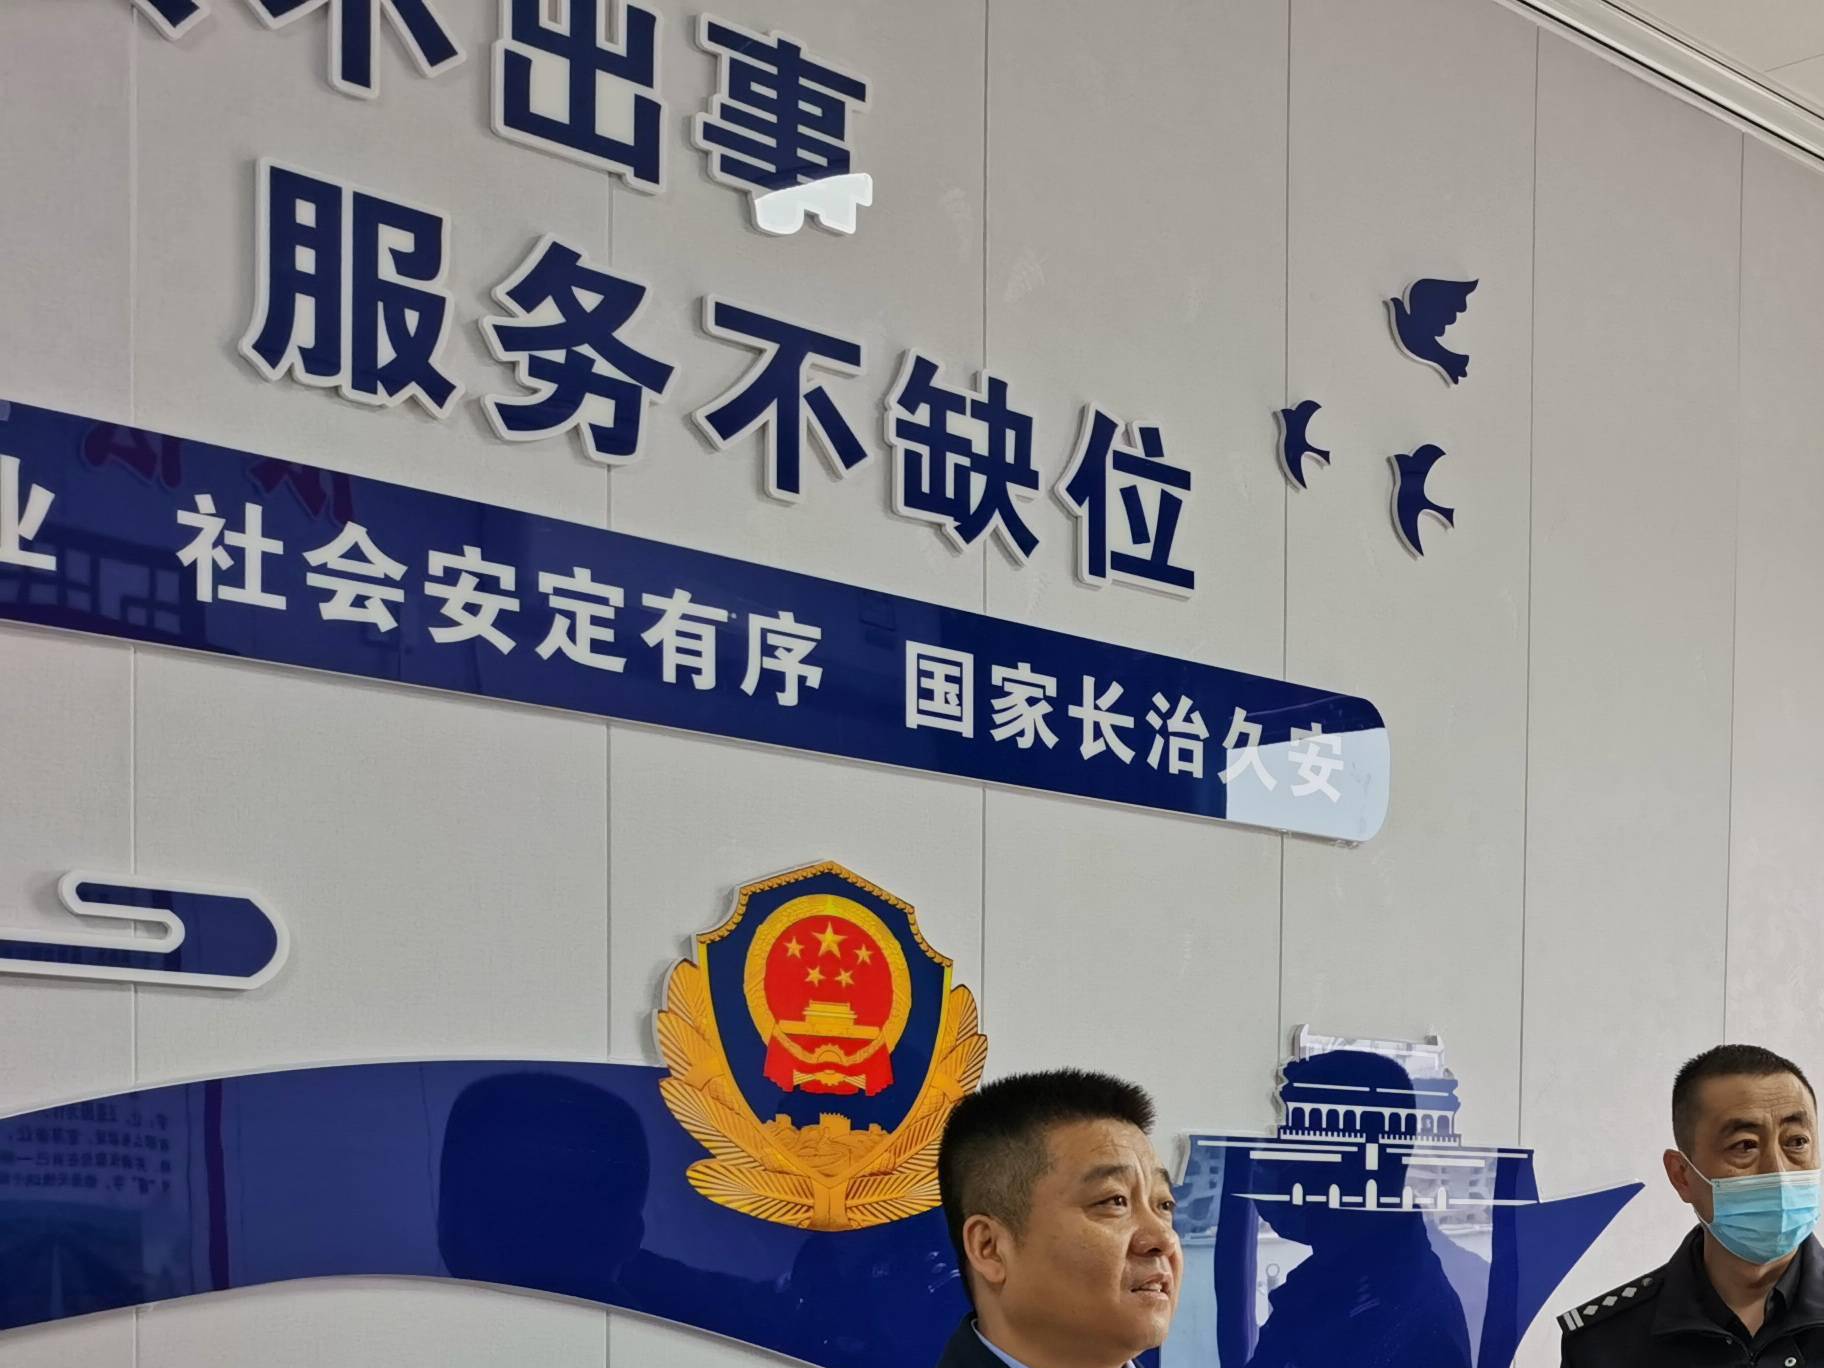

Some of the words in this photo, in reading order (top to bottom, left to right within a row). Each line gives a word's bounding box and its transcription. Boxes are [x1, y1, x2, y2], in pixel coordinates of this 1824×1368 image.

[132, 0, 871, 234] 出事
[244, 159, 1197, 593] 服务不缺位
[176, 494, 823, 706] 社会安定有序
[905, 640, 1345, 803] 国家长治久安
